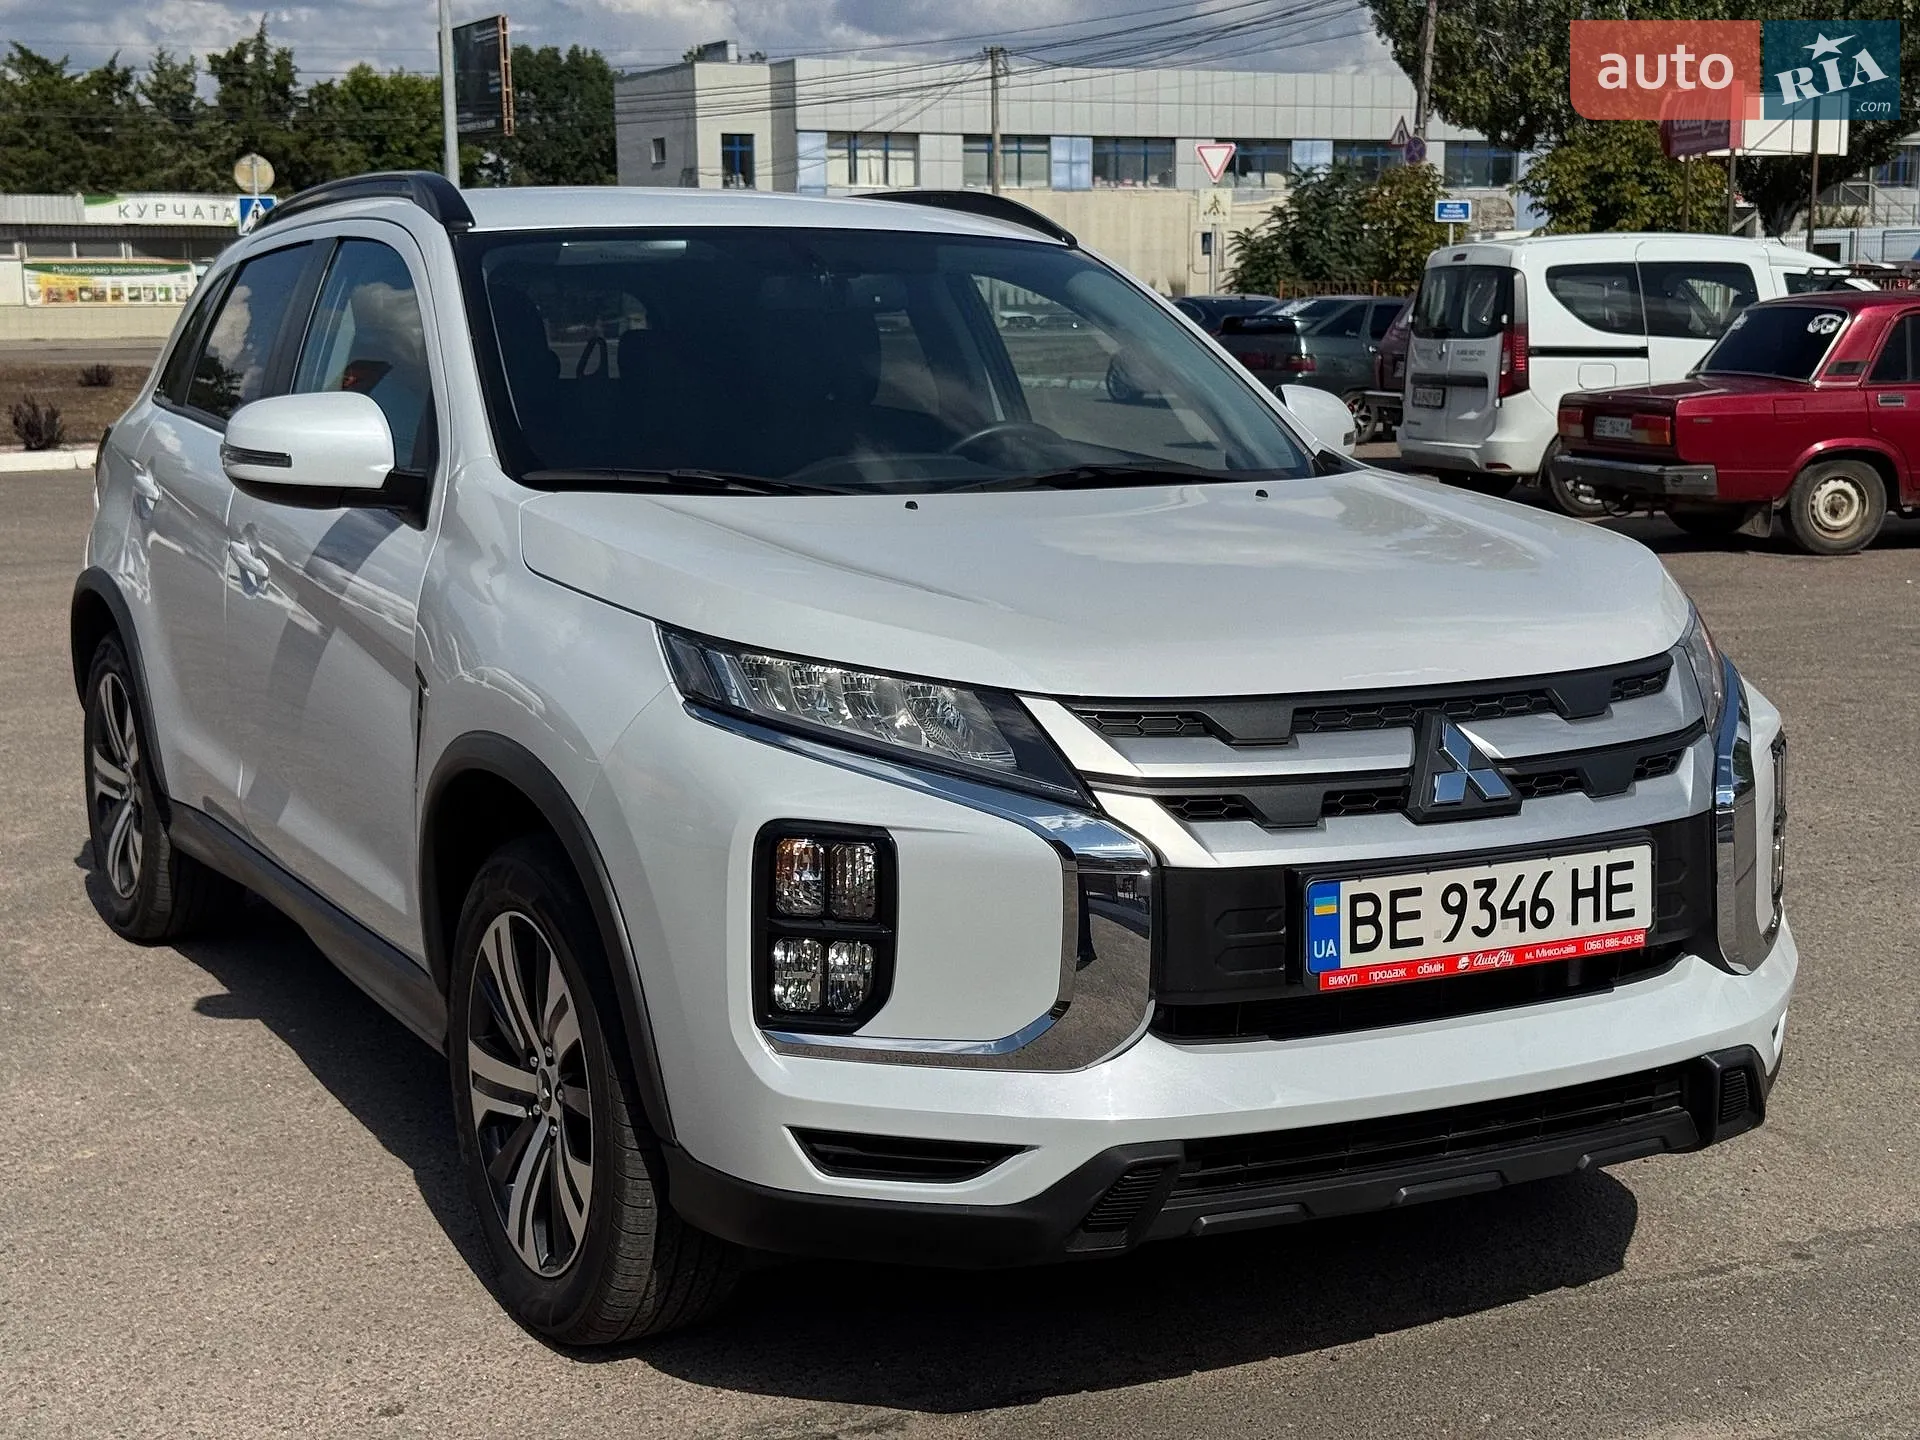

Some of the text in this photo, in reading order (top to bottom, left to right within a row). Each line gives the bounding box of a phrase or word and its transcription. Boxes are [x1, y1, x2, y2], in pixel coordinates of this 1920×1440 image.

[118, 203, 235, 221] КУРЧАТА
[1349, 860, 1636, 954] BE 9346 HE
[1313, 938, 1338, 959] UA
[1328, 960, 1445, 986] викуп продаж обмін
